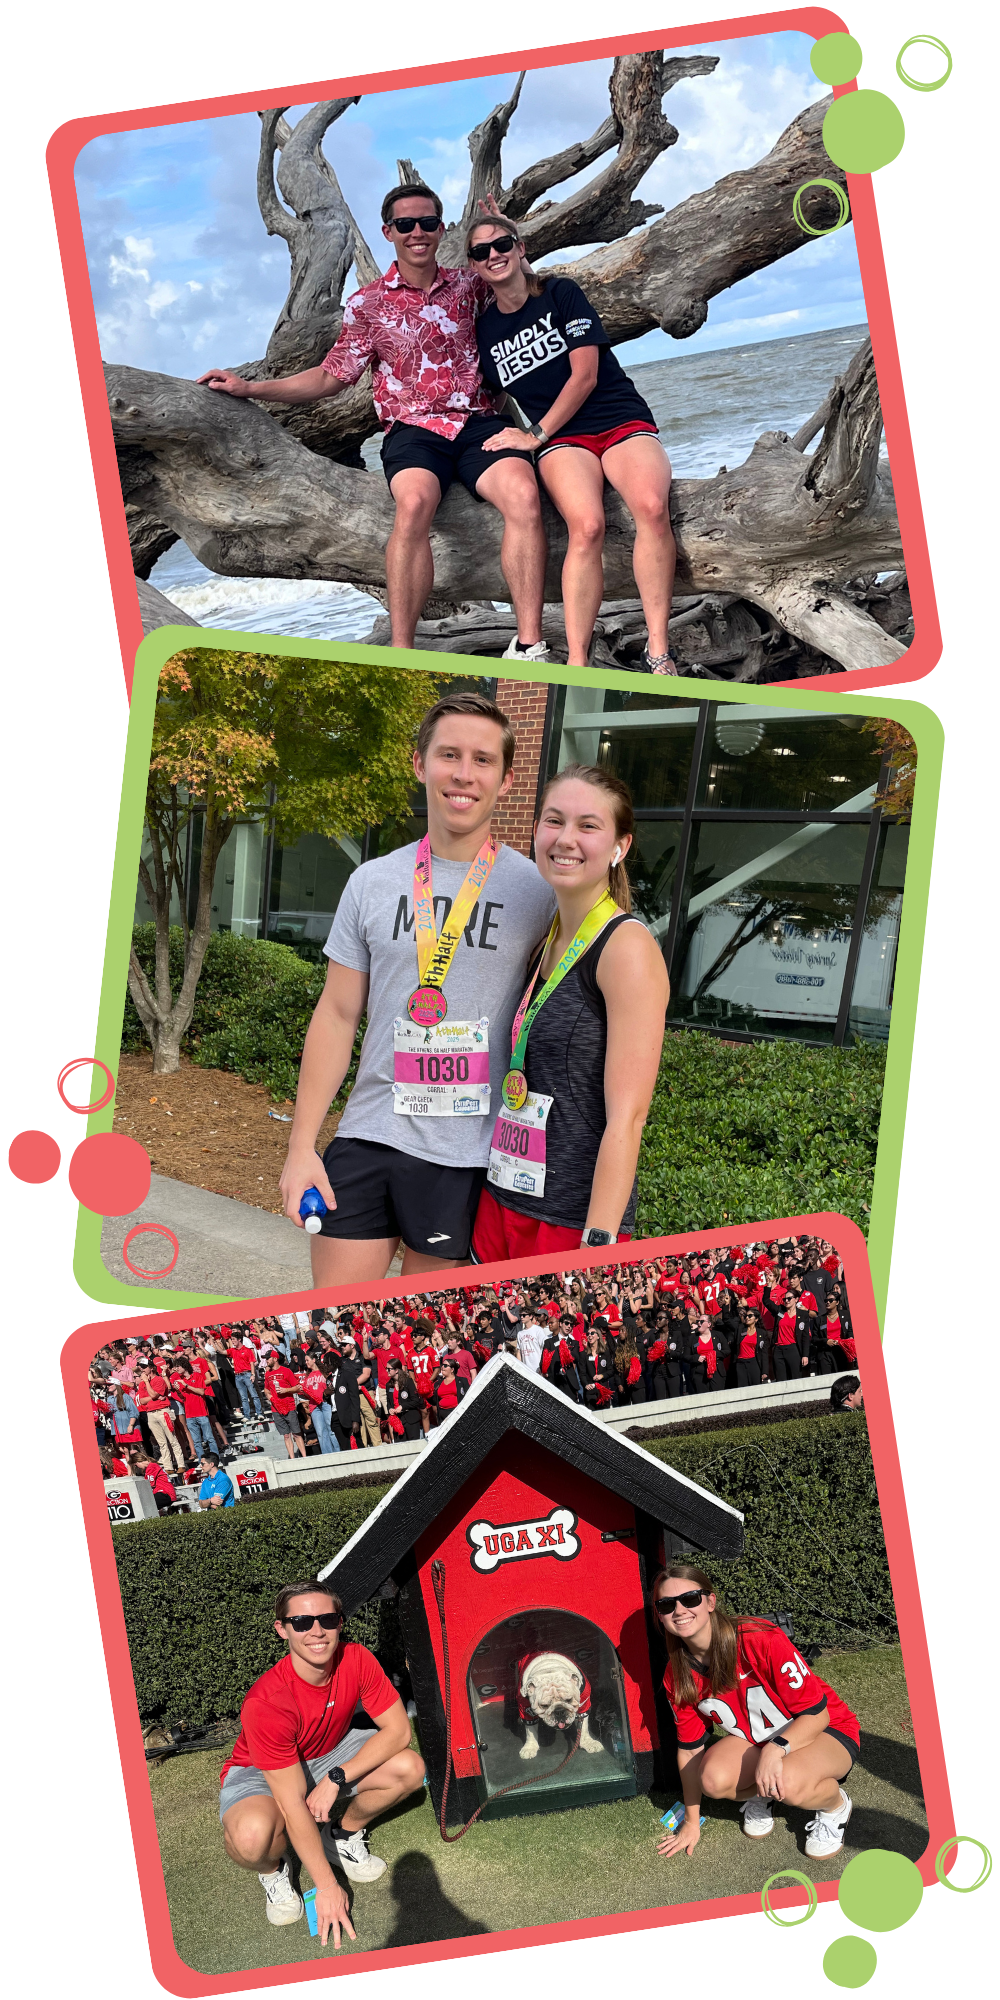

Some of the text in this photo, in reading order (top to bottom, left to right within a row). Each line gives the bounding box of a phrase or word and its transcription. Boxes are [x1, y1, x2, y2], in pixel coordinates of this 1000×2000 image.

[490, 312, 553, 363] SIMPLY
[503, 334, 564, 382] JESUS
[469, 857, 490, 888] 2025
[416, 899, 432, 931] 2025
[559, 938, 585, 971] 2025
[415, 1056, 469, 1082] 1030
[409, 1103, 428, 1113] 1030
[498, 1122, 529, 1156] 3030
[704, 1283, 720, 1302] 27
[411, 1355, 429, 1374] 27
[240, 1476, 265, 1485] SECTION
[246, 1483, 263, 1494] 111
[106, 1497, 129, 1506] ECTION
[108, 1504, 131, 1520] 110
[483, 1523, 566, 1556] UGA XI
[781, 1651, 811, 1689] 34
